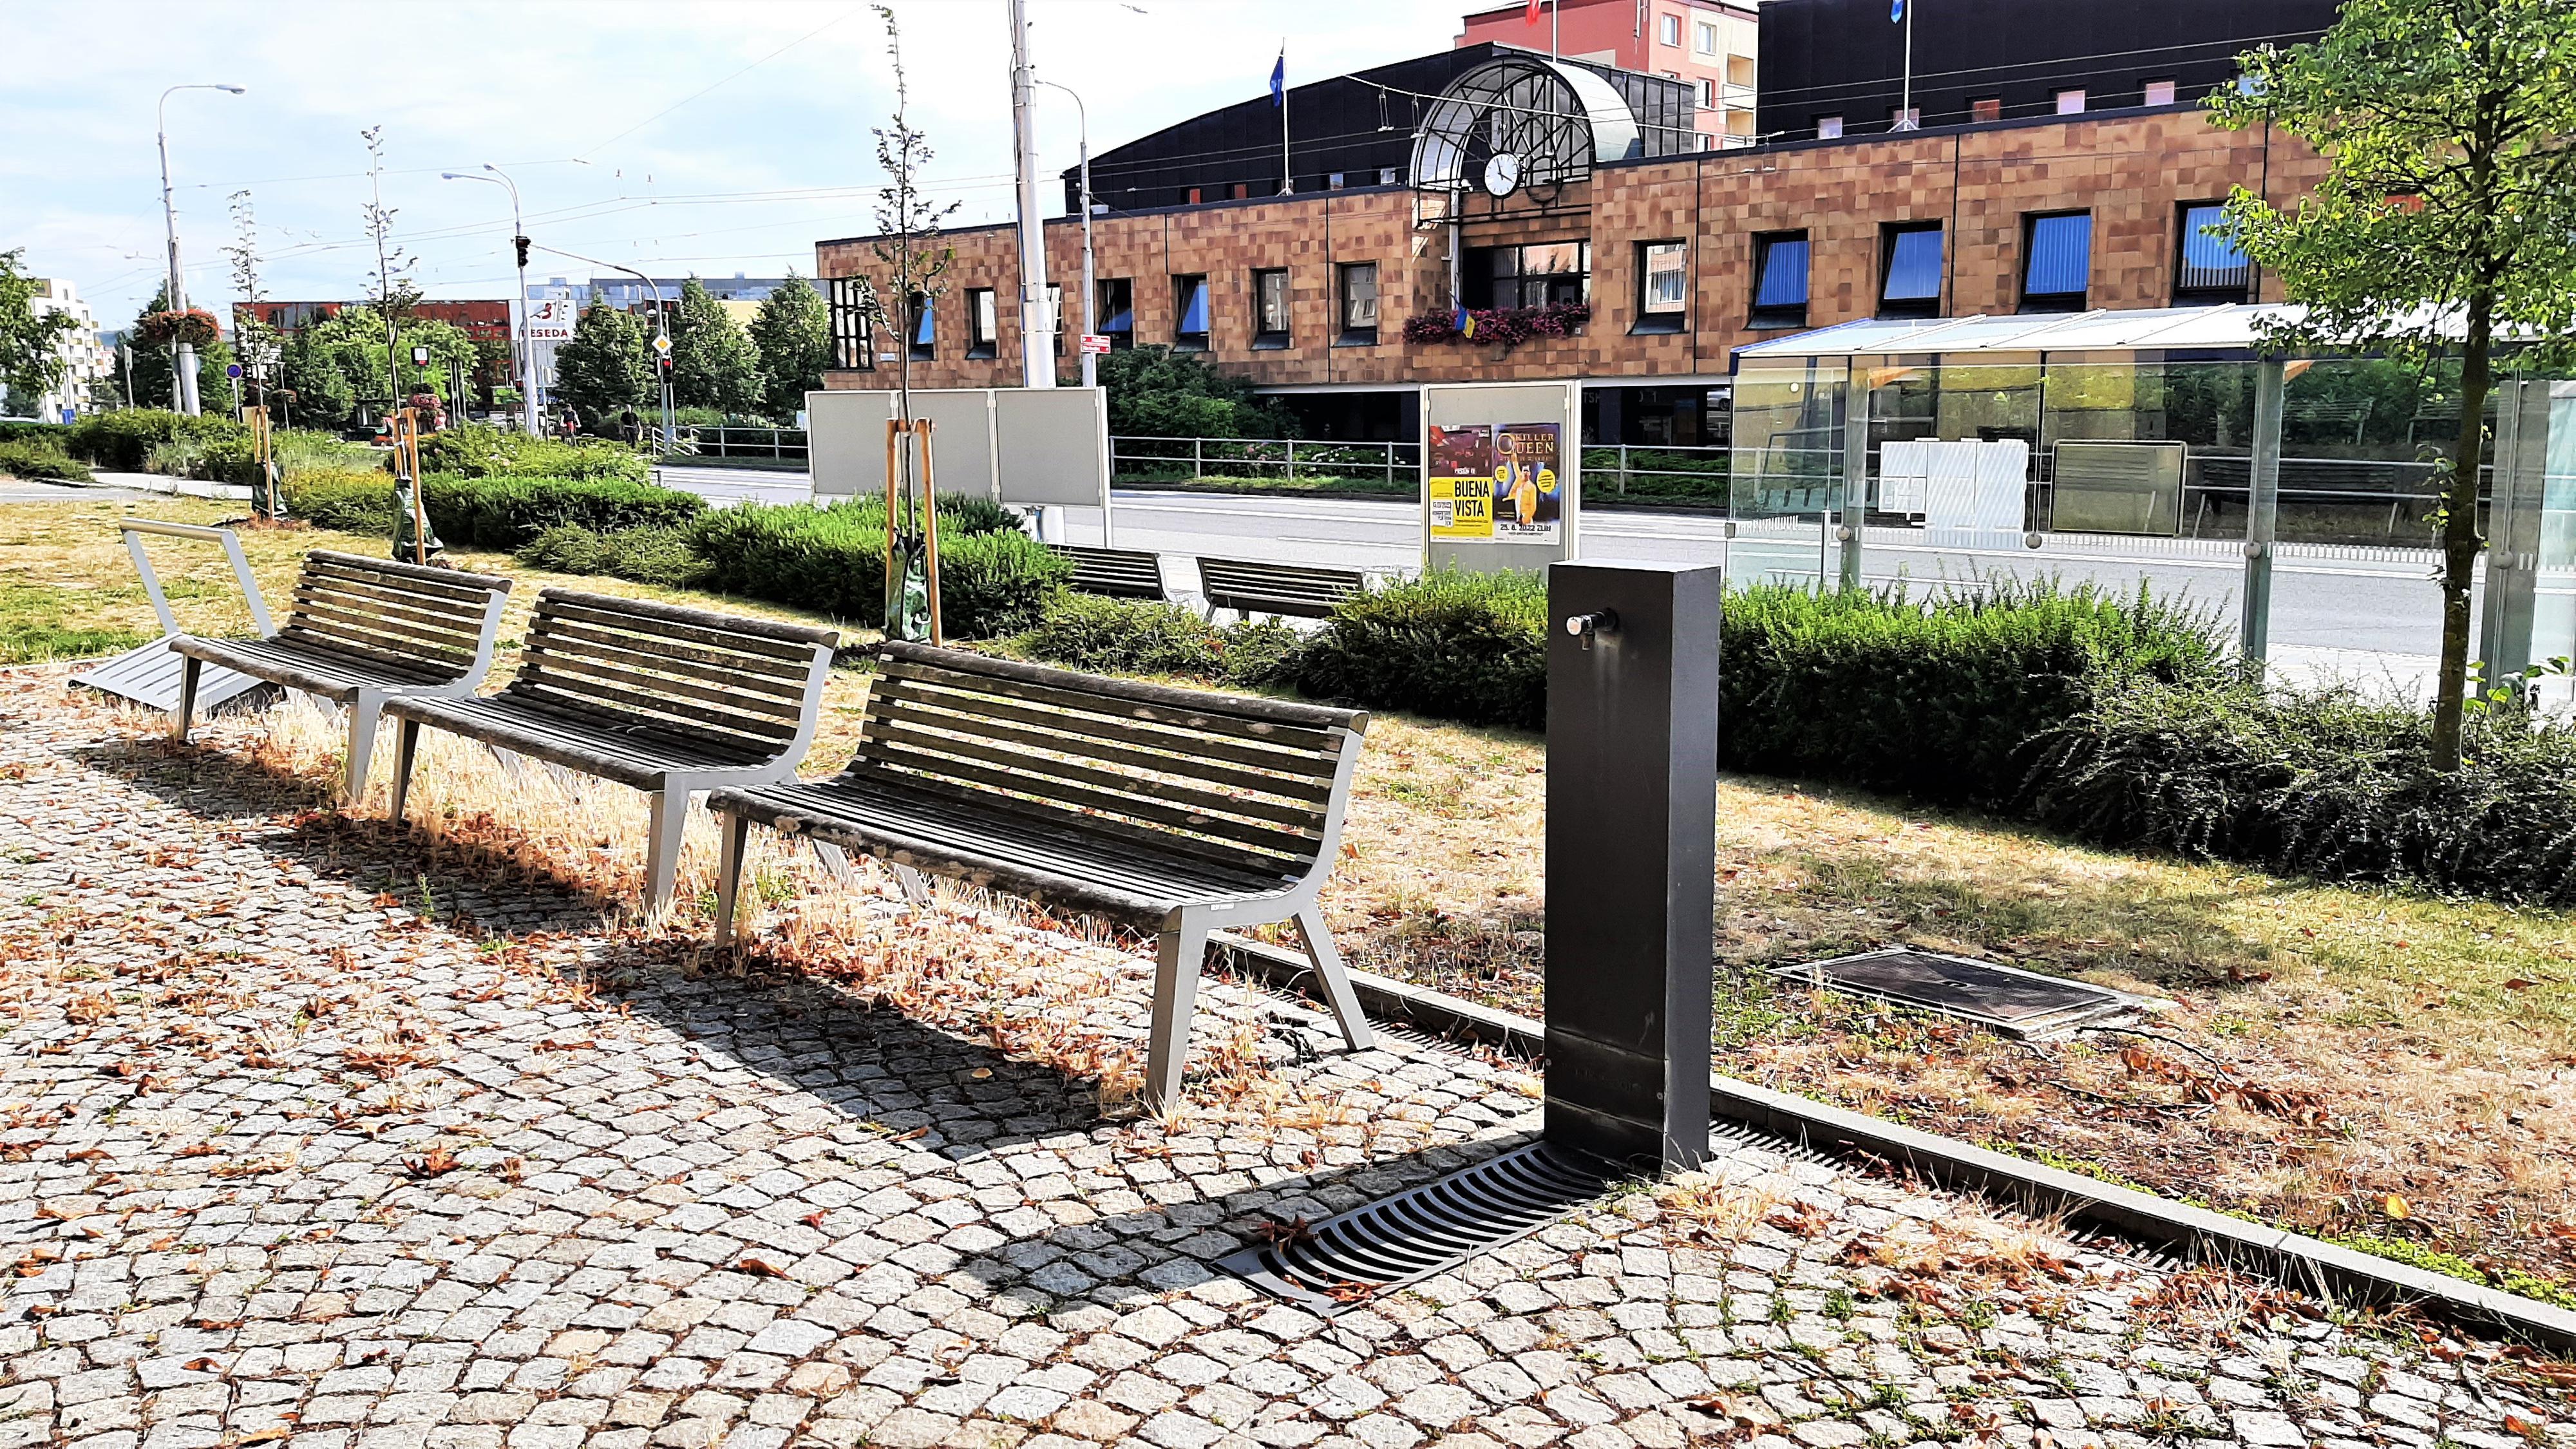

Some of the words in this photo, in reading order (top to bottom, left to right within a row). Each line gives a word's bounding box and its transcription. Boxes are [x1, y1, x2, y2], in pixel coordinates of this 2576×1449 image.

[1497, 433, 1554, 455] QUEEN
[1454, 480, 1490, 497] BUENA
[1454, 500, 1484, 516] VISTA
